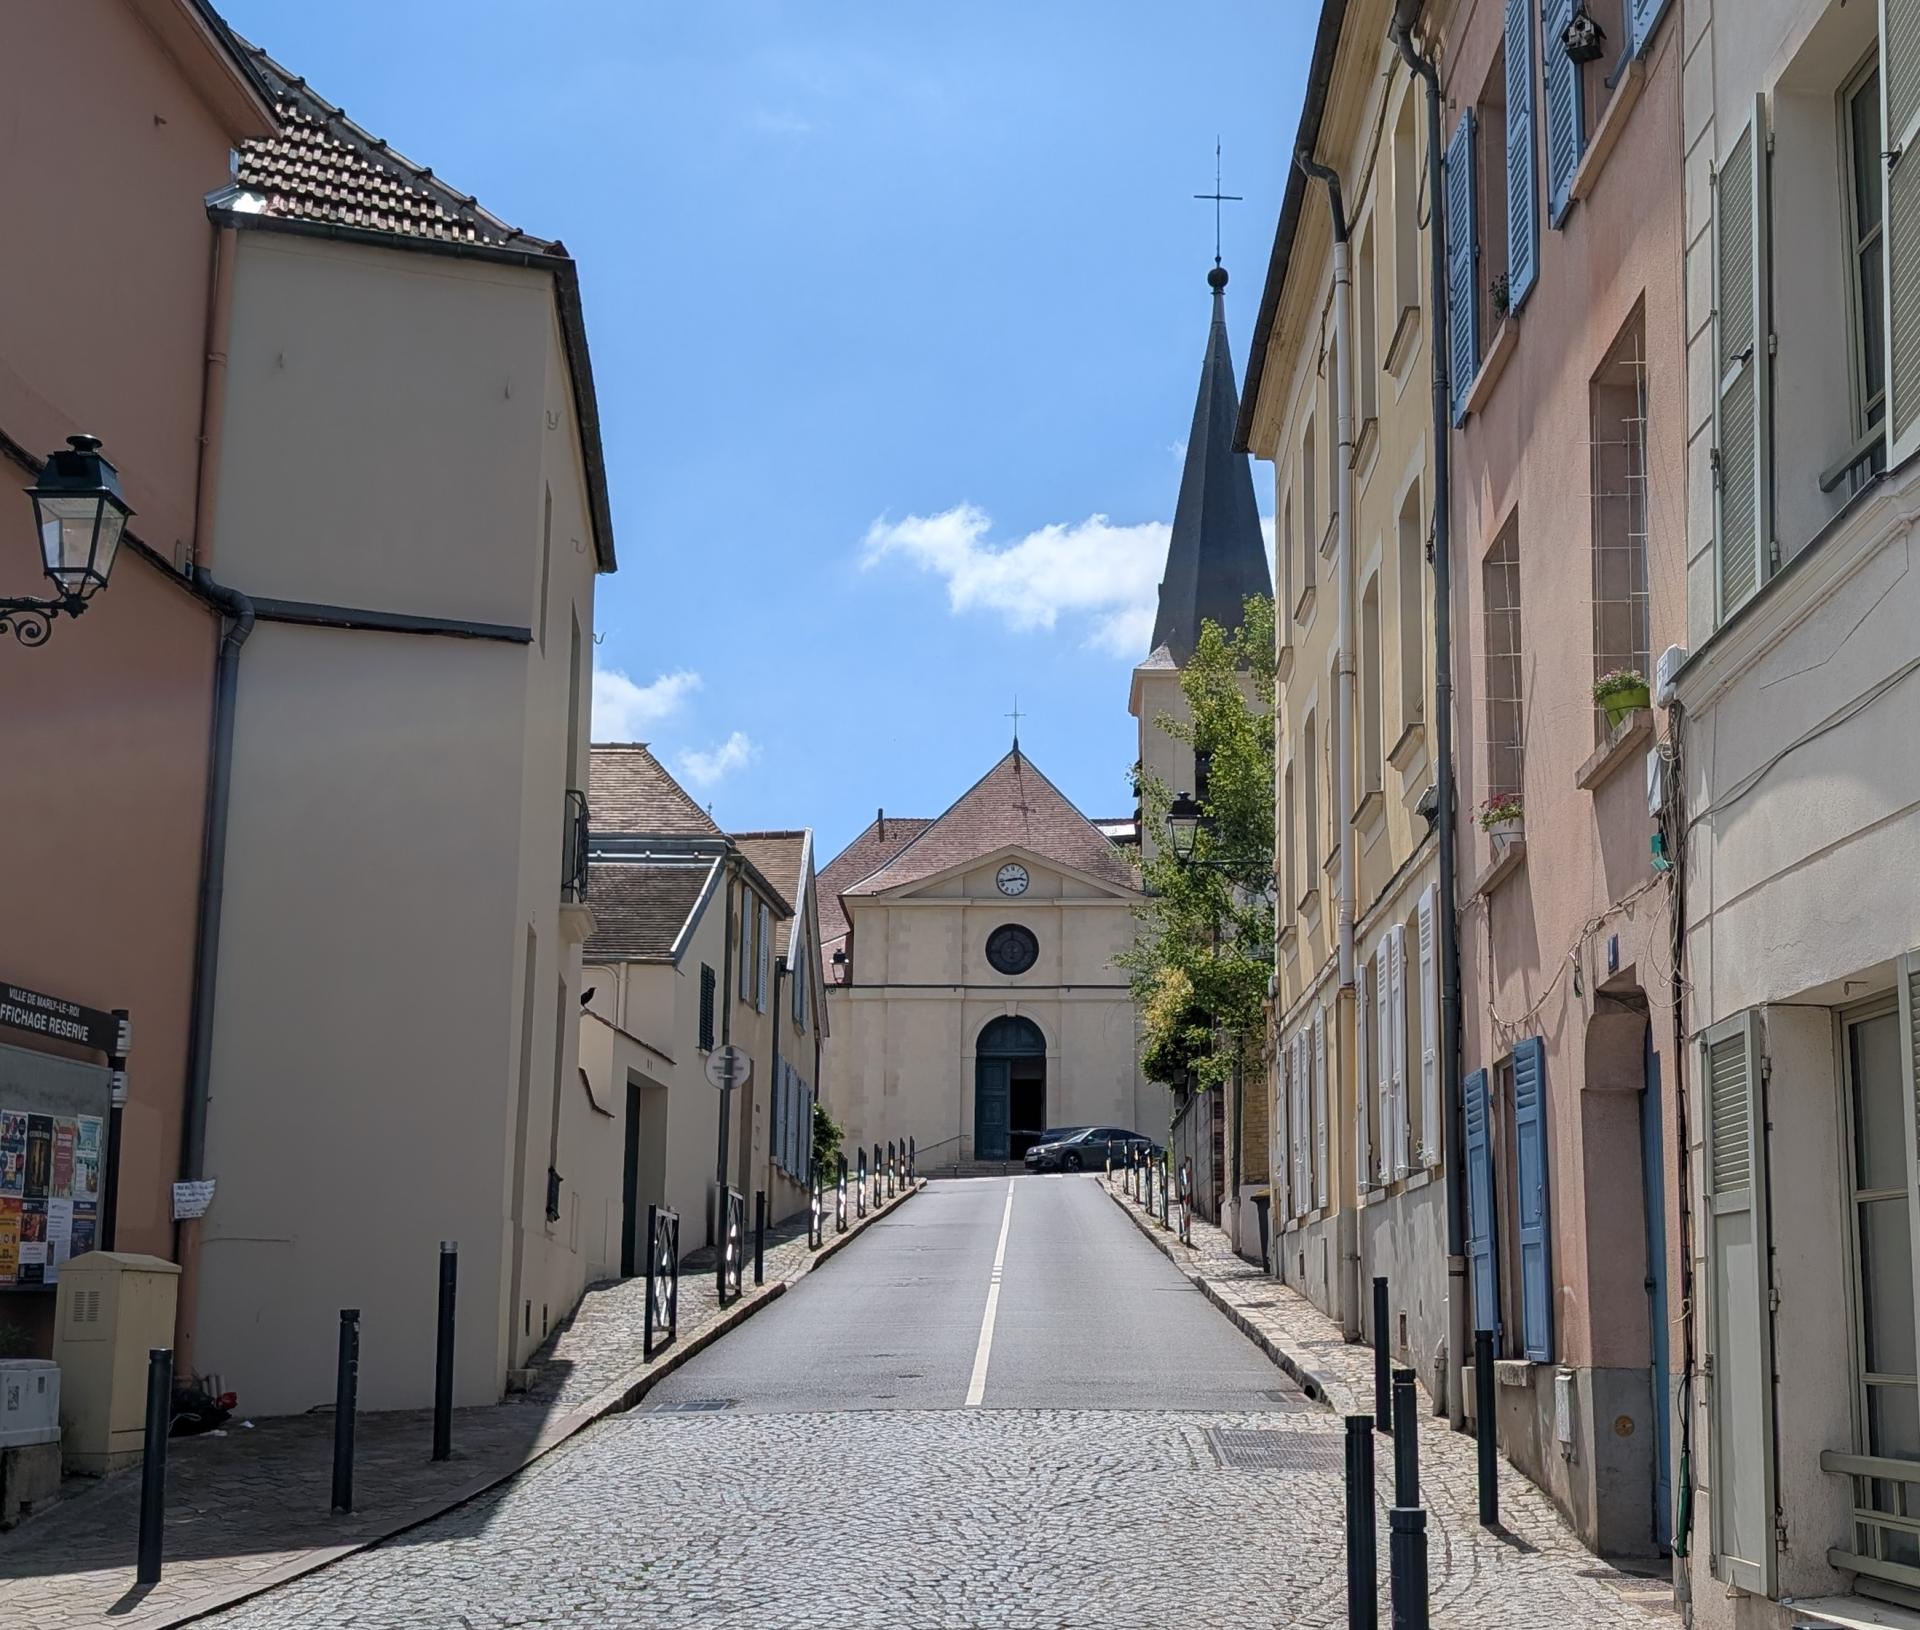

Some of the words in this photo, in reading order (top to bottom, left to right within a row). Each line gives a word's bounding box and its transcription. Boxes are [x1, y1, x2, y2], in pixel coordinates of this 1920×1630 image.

[9, 987, 26, 1002] VILLE
[27, 993, 36, 1005] DE
[0, 1003, 47, 1031] FFICHAGE
[48, 1016, 89, 1041] RESERVE
